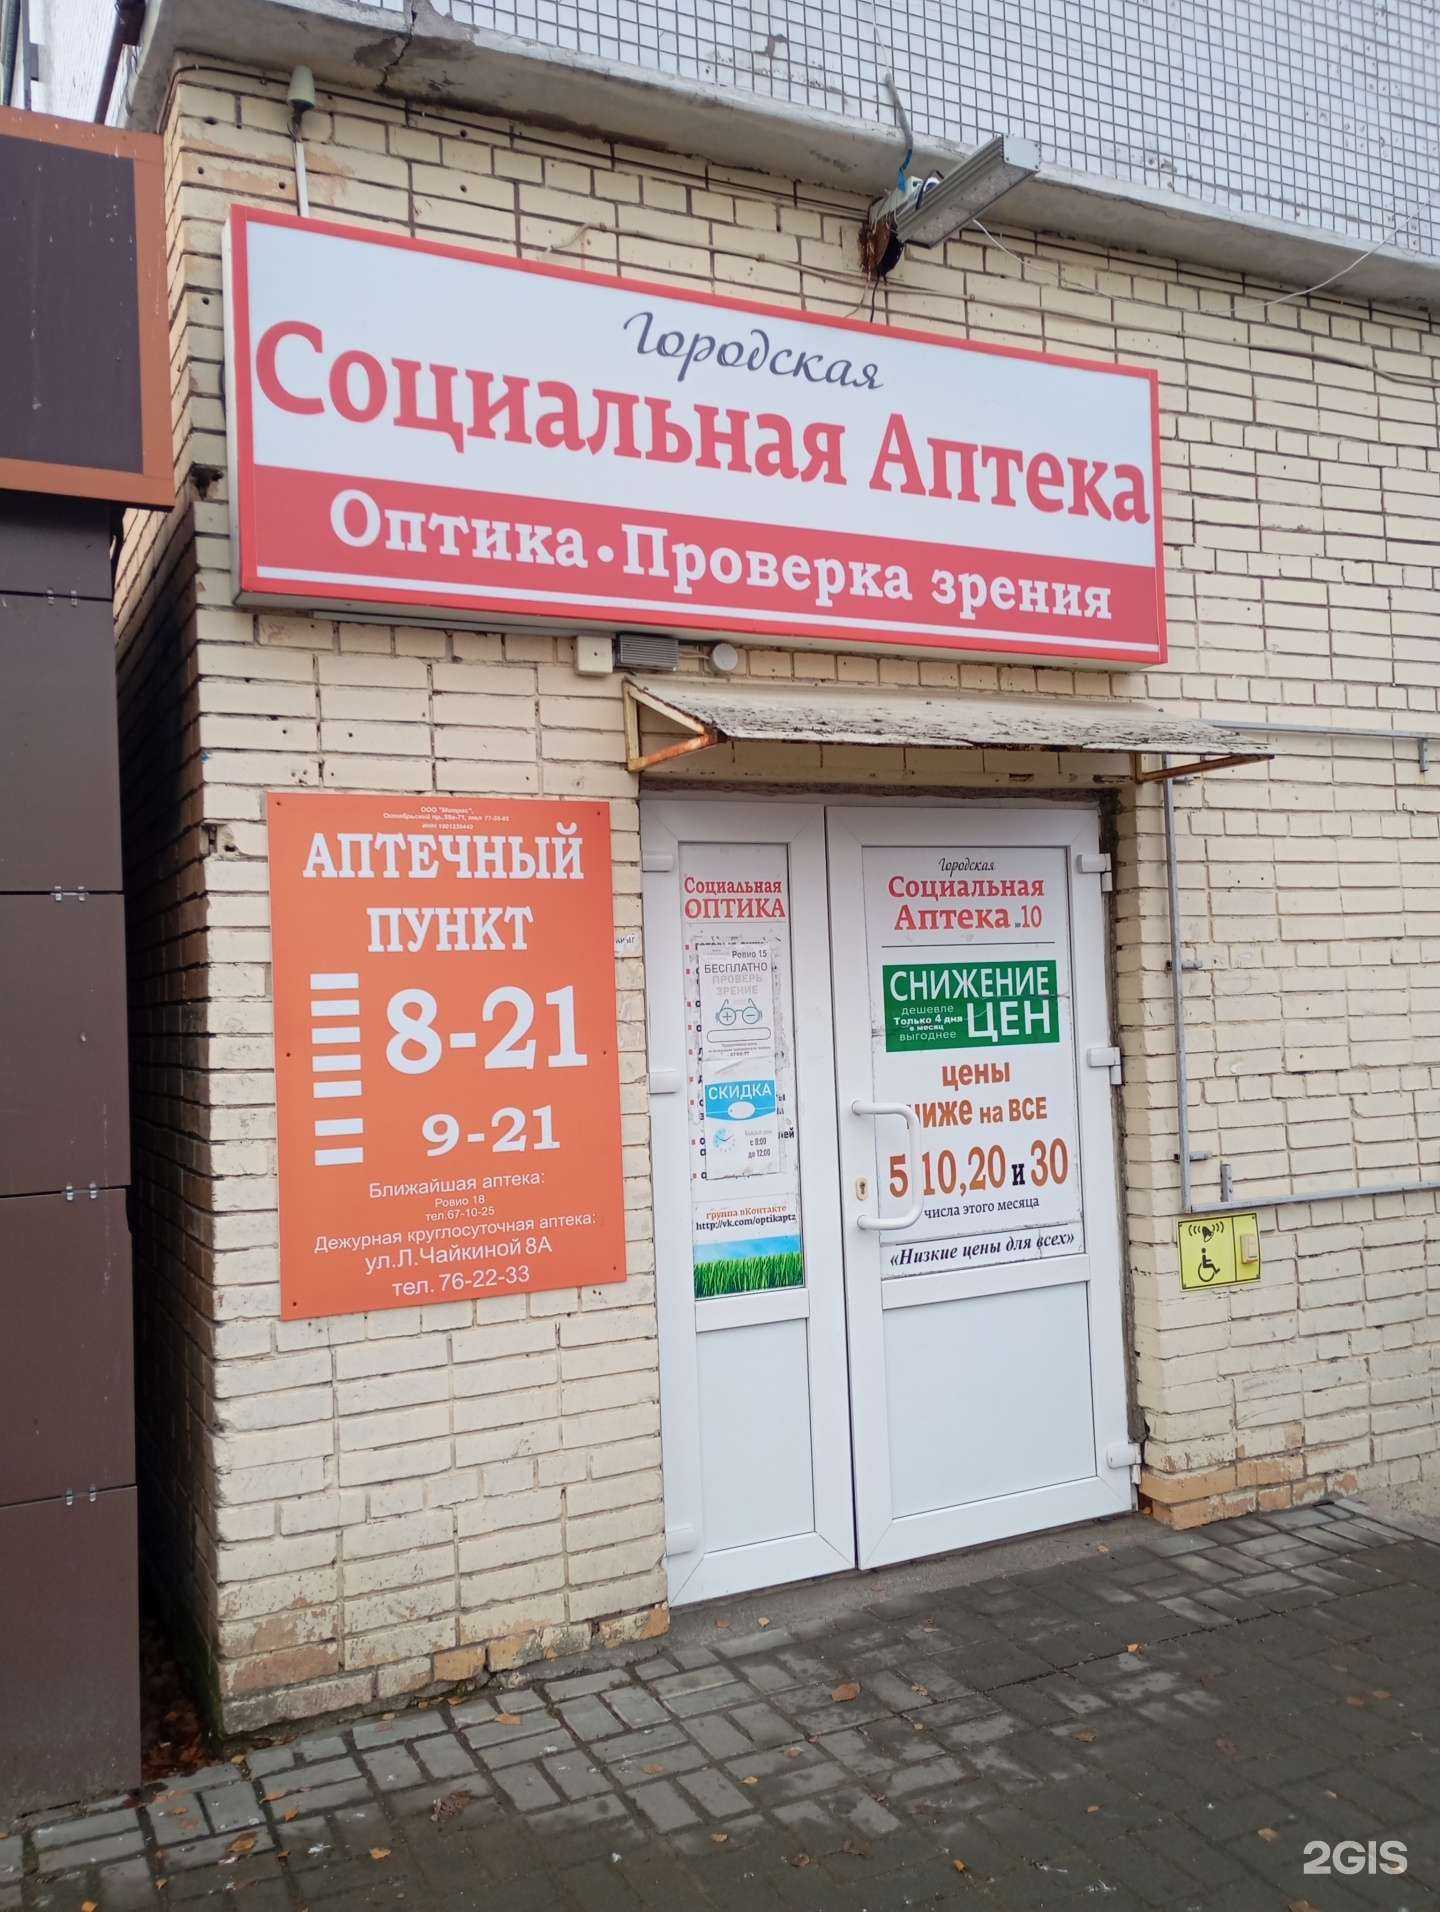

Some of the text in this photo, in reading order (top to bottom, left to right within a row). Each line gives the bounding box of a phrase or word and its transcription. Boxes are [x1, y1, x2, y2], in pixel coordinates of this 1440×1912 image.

[624, 312, 884, 390] Городская
[256, 320, 1150, 524] Социальная Аптека
[330, 489, 1112, 620] Оптика Проверка зрения
[302, 821, 585, 880] АПТЕЧНЫЙ
[938, 857, 995, 877] Городская
[684, 877, 782, 895] Социальная
[888, 875, 1045, 901] Социальная
[684, 898, 786, 919] ОПТИКА
[894, 904, 1012, 931] Аптека
[366, 905, 534, 953] ПУНКТ
[704, 962, 768, 974] БЕСПЛАТНО
[712, 974, 762, 985] ПРОВЕРЬ
[716, 985, 758, 996] ЗРЕНИЕ
[889, 965, 1050, 1002] СНИЖЕНИЕ
[893, 1014, 963, 1026] Только 4 дня
[901, 1004, 954, 1016] дешевле
[966, 999, 1051, 1043] ЦЕН
[385, 985, 588, 1075] 8-21
[899, 1031, 957, 1041] выгоднее
[942, 1061, 1011, 1092] цены
[708, 1083, 772, 1101] СКИДКА
[979, 1105, 1003, 1124] на
[1008, 1096, 1048, 1122] ВСЕ
[421, 1104, 561, 1157] 9-21
[1011, 1163, 1026, 1186] и
[1029, 1137, 1069, 1188] 30
[368, 1171, 546, 1199] Ближайшая аптека:
[434, 1194, 485, 1208] Ровио 18
[924, 1197, 1039, 1219] числа этого месяца
[695, 1213, 797, 1231] http://vk.com/optikaptz
[705, 1209, 739, 1221] группа
[313, 1212, 597, 1254] Дежурная круглосуточная аптека:
[525, 1236, 553, 1255] 8А
[889, 1232, 1075, 1267] «Низкие цены для всех»
[391, 1264, 531, 1298] тел. 76-22-33
